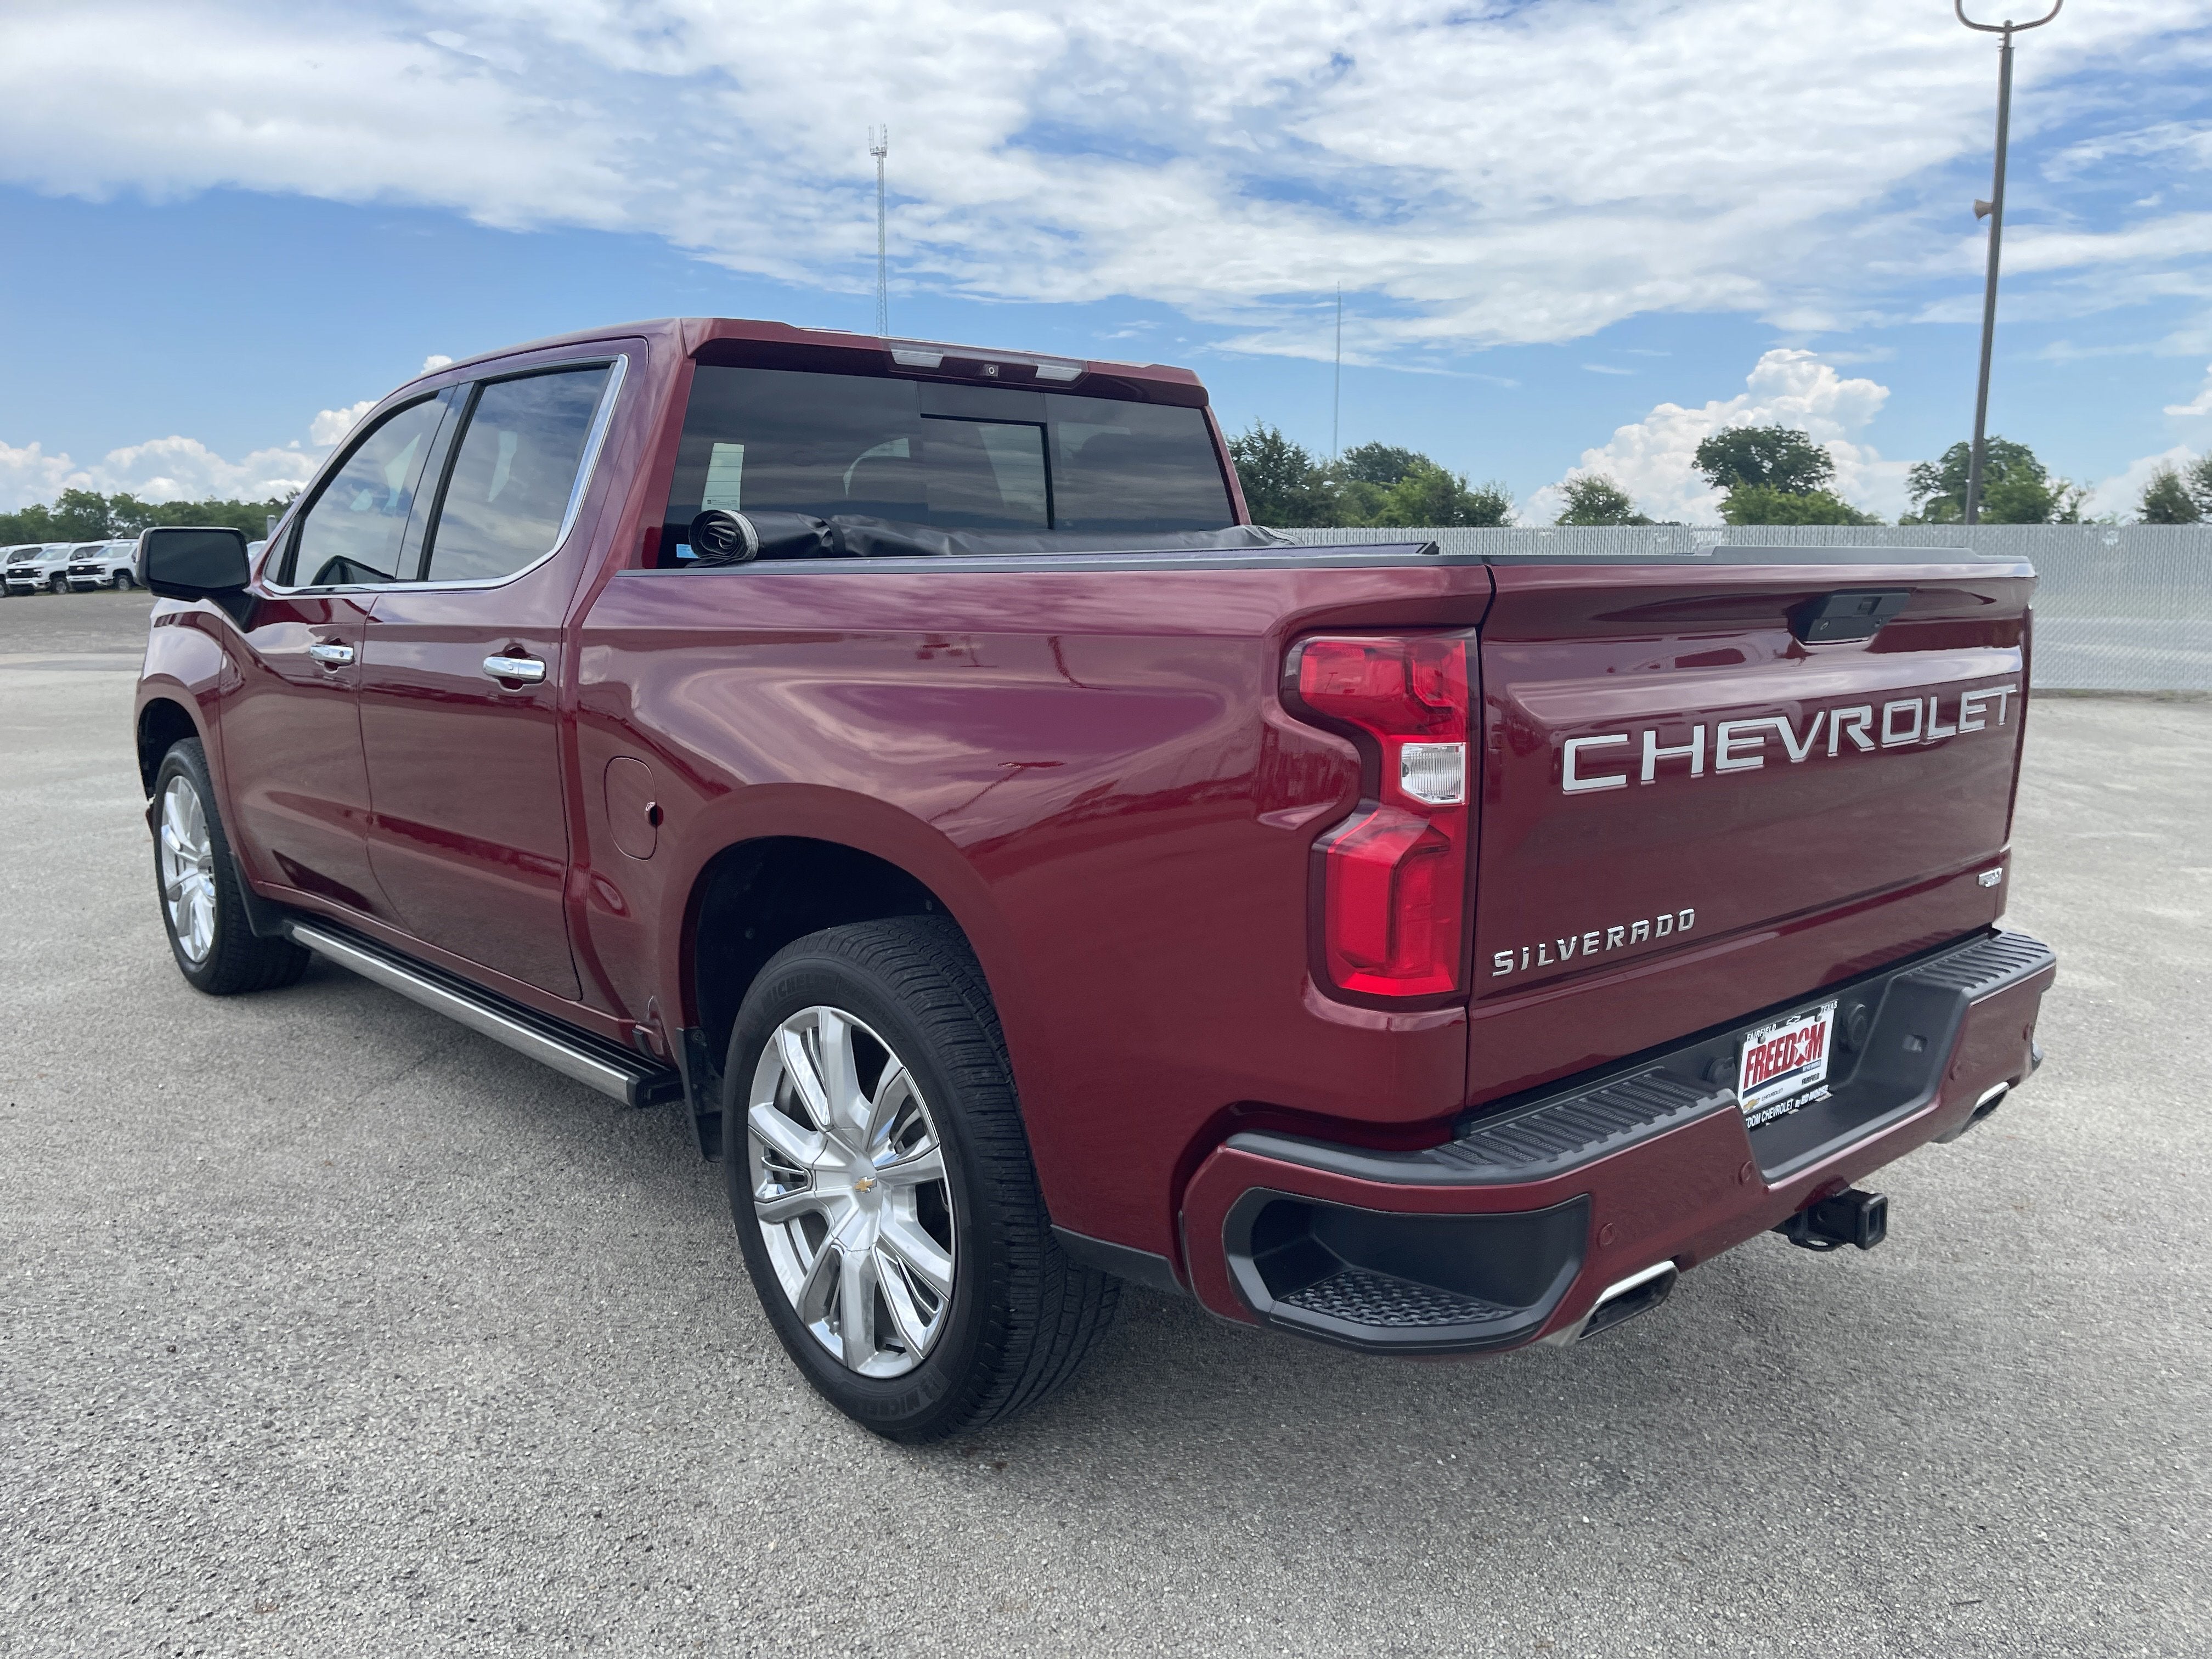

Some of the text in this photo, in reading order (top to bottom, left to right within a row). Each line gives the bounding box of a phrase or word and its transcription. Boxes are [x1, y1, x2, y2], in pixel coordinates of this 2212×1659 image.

[1562, 684, 2017, 795] CHEVROLET
[1492, 908, 1696, 976] SILVERADO
[1747, 1001, 1838, 1042] FAIRFIELD TEXAS
[1743, 1021, 1826, 1089] FREEDOM
[1761, 1088, 1783, 1101] CHEVROLET
[1761, 1098, 1794, 1122] CHEVROLET
